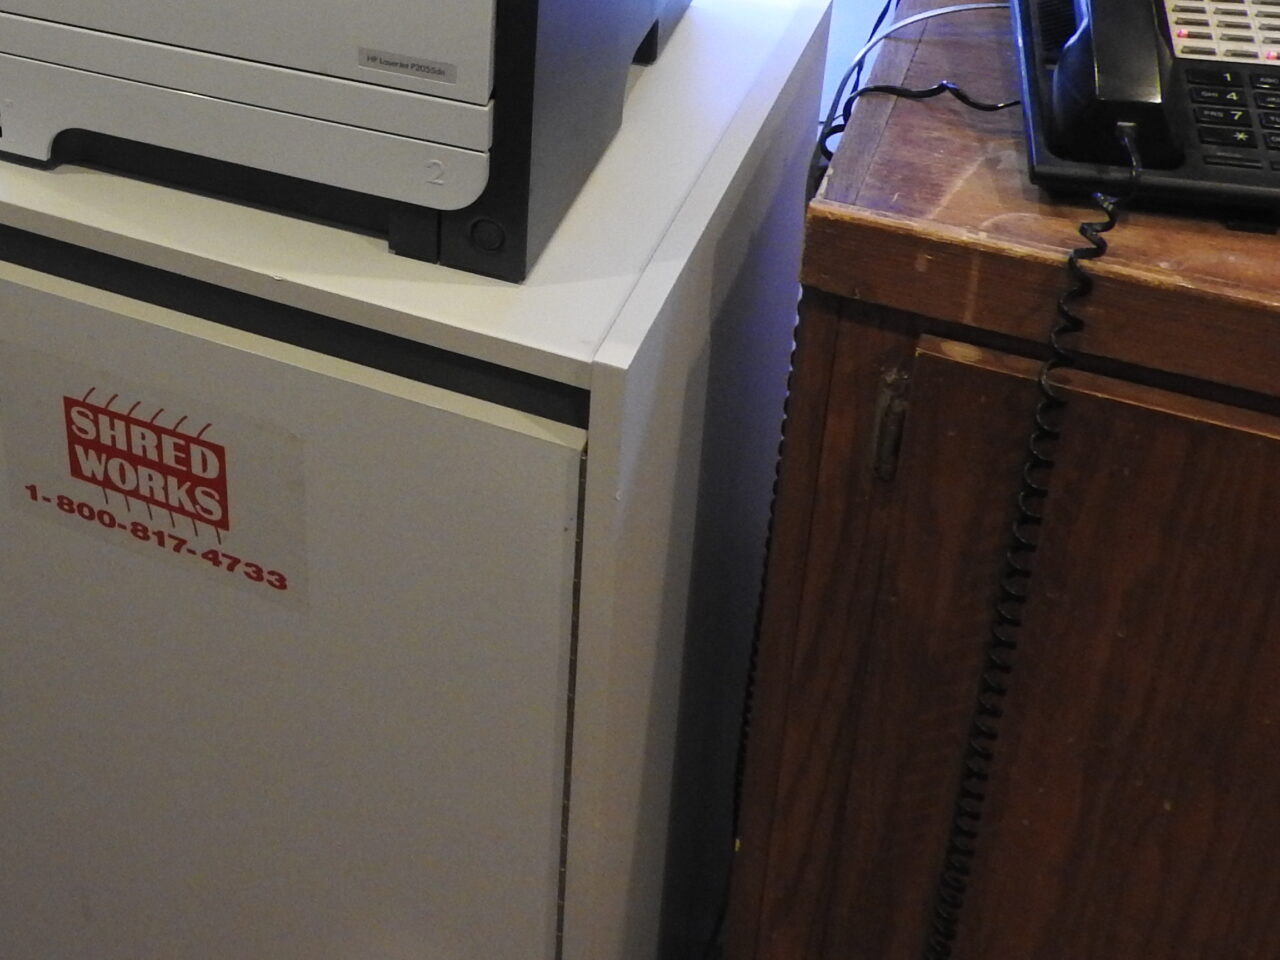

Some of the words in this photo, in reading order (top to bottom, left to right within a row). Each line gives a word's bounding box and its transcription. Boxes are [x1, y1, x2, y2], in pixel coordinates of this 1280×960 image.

[1223, 72, 1232, 82] 1
[1226, 91, 1238, 101] 4
[1230, 110, 1243, 121] 7
[70, 405, 220, 480] SHRED
[74, 444, 223, 522] WORKS
[24, 483, 289, 591] 1-800-817-4733
